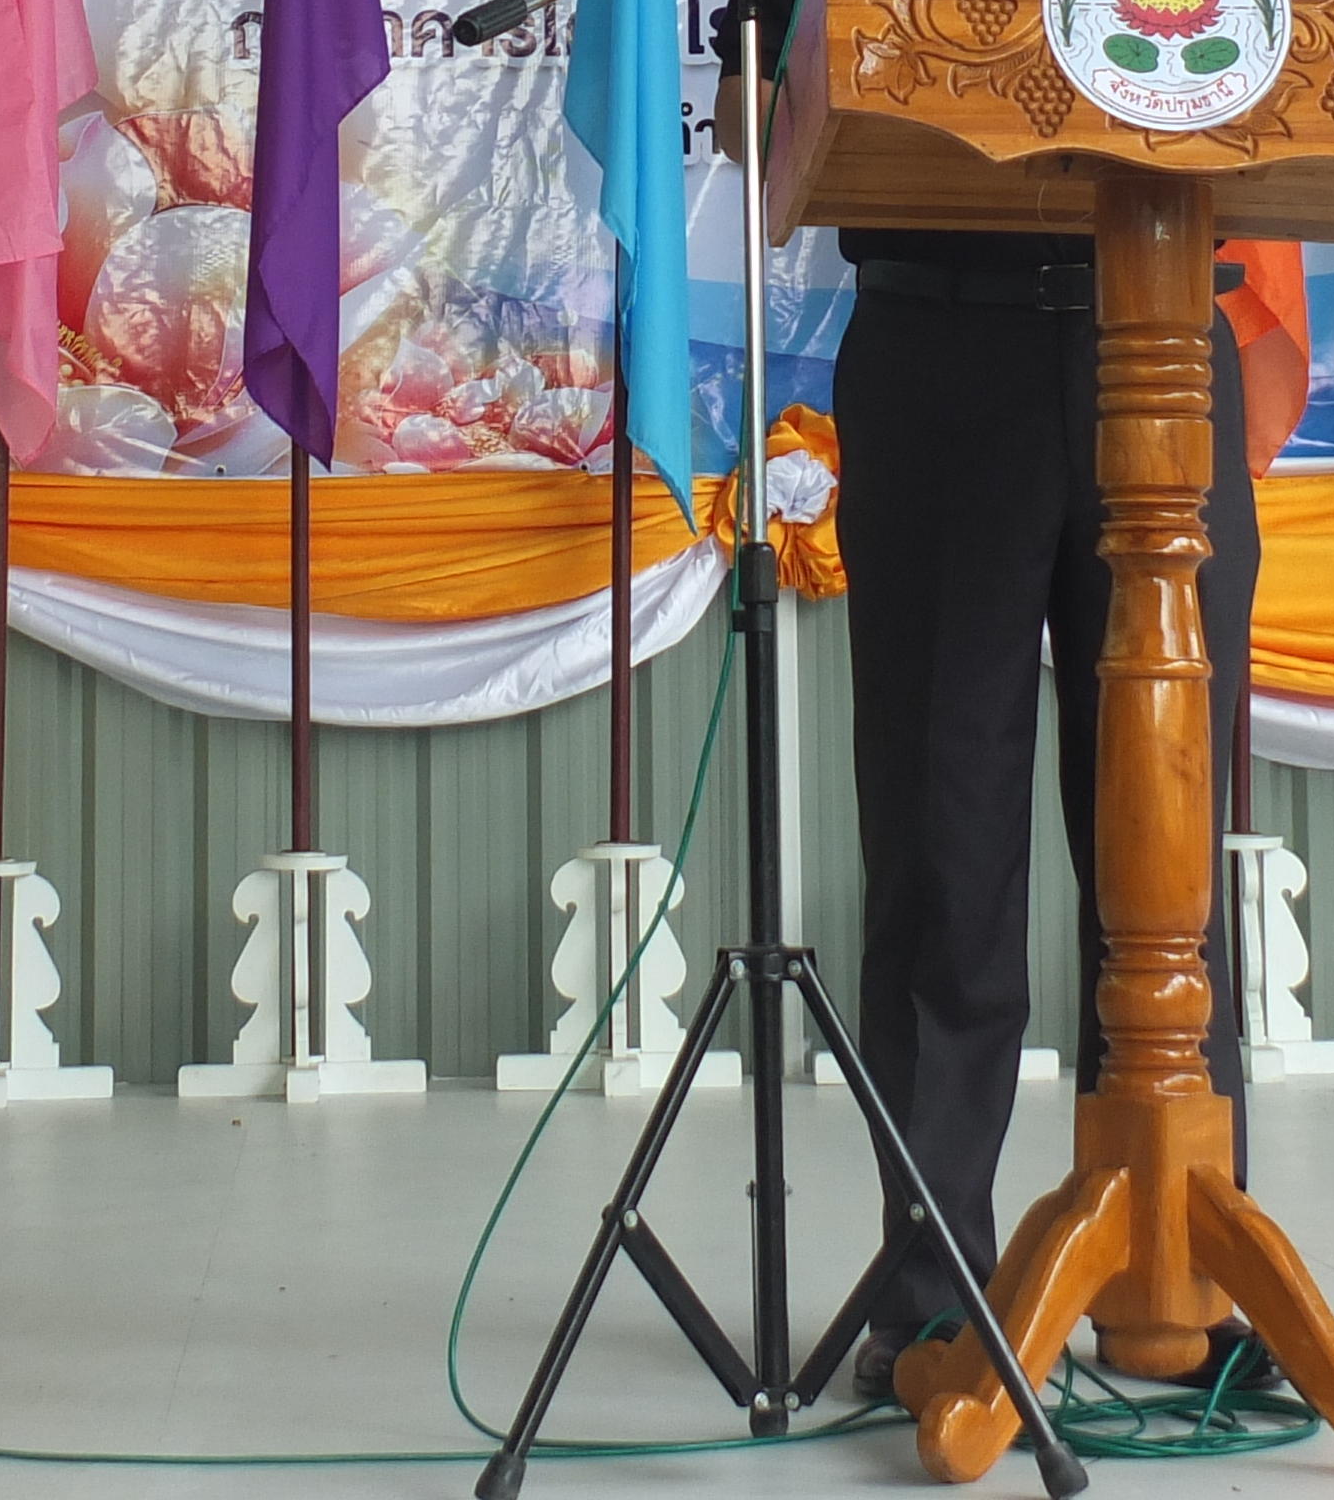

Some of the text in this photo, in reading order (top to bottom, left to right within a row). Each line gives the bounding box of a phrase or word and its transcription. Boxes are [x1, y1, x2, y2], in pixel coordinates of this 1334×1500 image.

[1109, 78, 1234, 118] จังหวัดปทุมธานี
